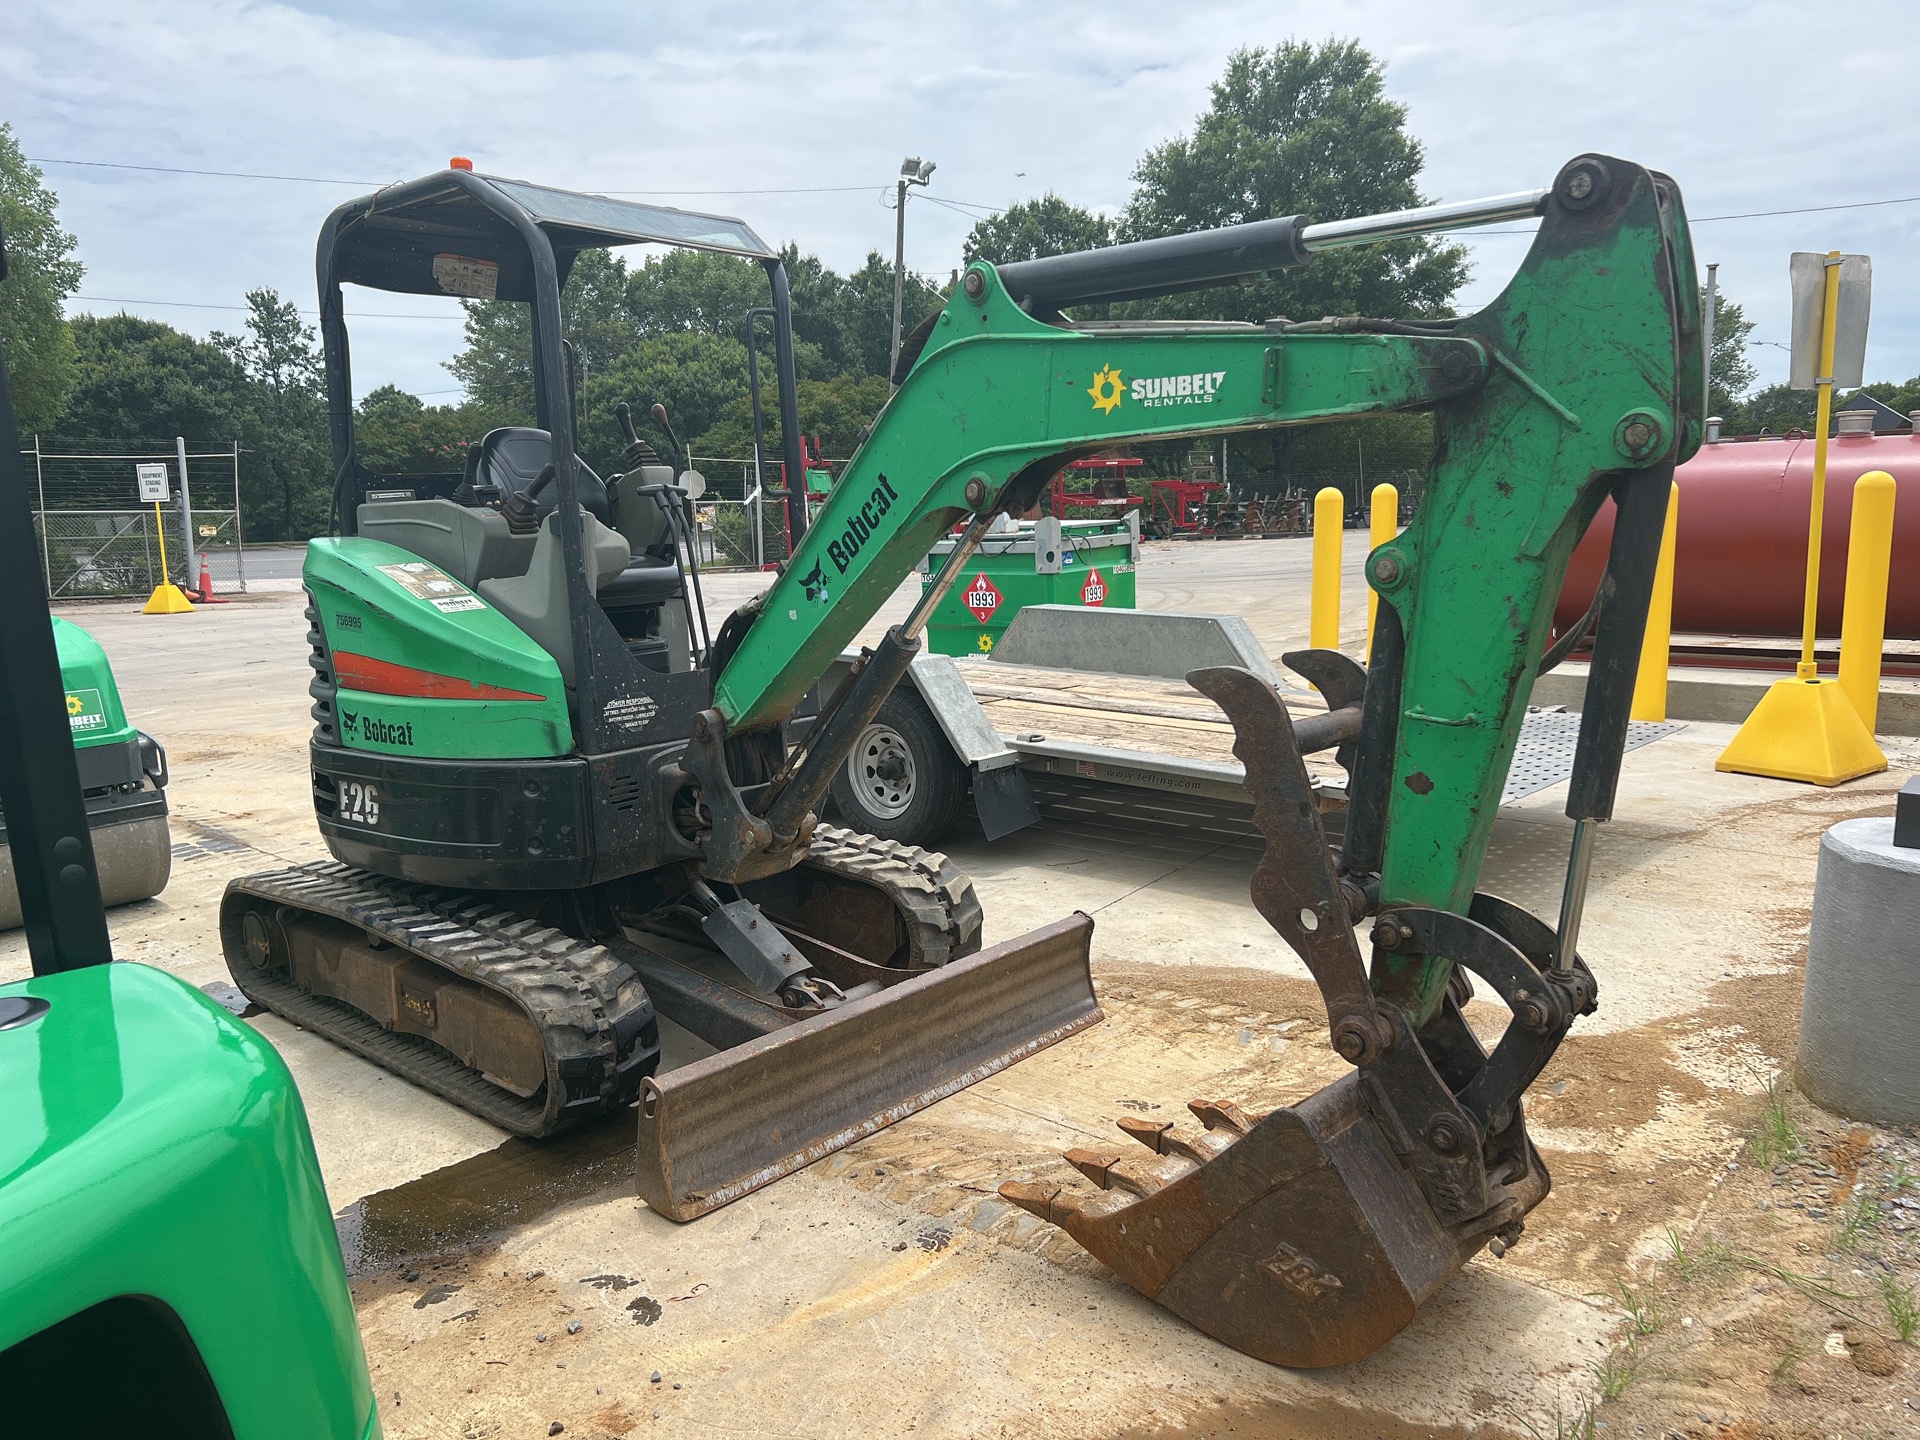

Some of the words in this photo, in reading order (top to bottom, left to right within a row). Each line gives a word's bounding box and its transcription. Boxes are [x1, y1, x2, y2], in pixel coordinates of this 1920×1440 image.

[1131, 371, 1226, 400] SUNBELT
[1144, 395, 1213, 408] RENTALS
[827, 472, 898, 575] Bobcat
[969, 592, 995, 607] 1993
[1085, 585, 1103, 602] 1993
[336, 614, 362, 629] 756995
[980, 611, 986, 620] 3
[362, 716, 414, 746] Bobcat
[1106, 769, 1201, 790] www.felling.com
[338, 780, 380, 825] E26
